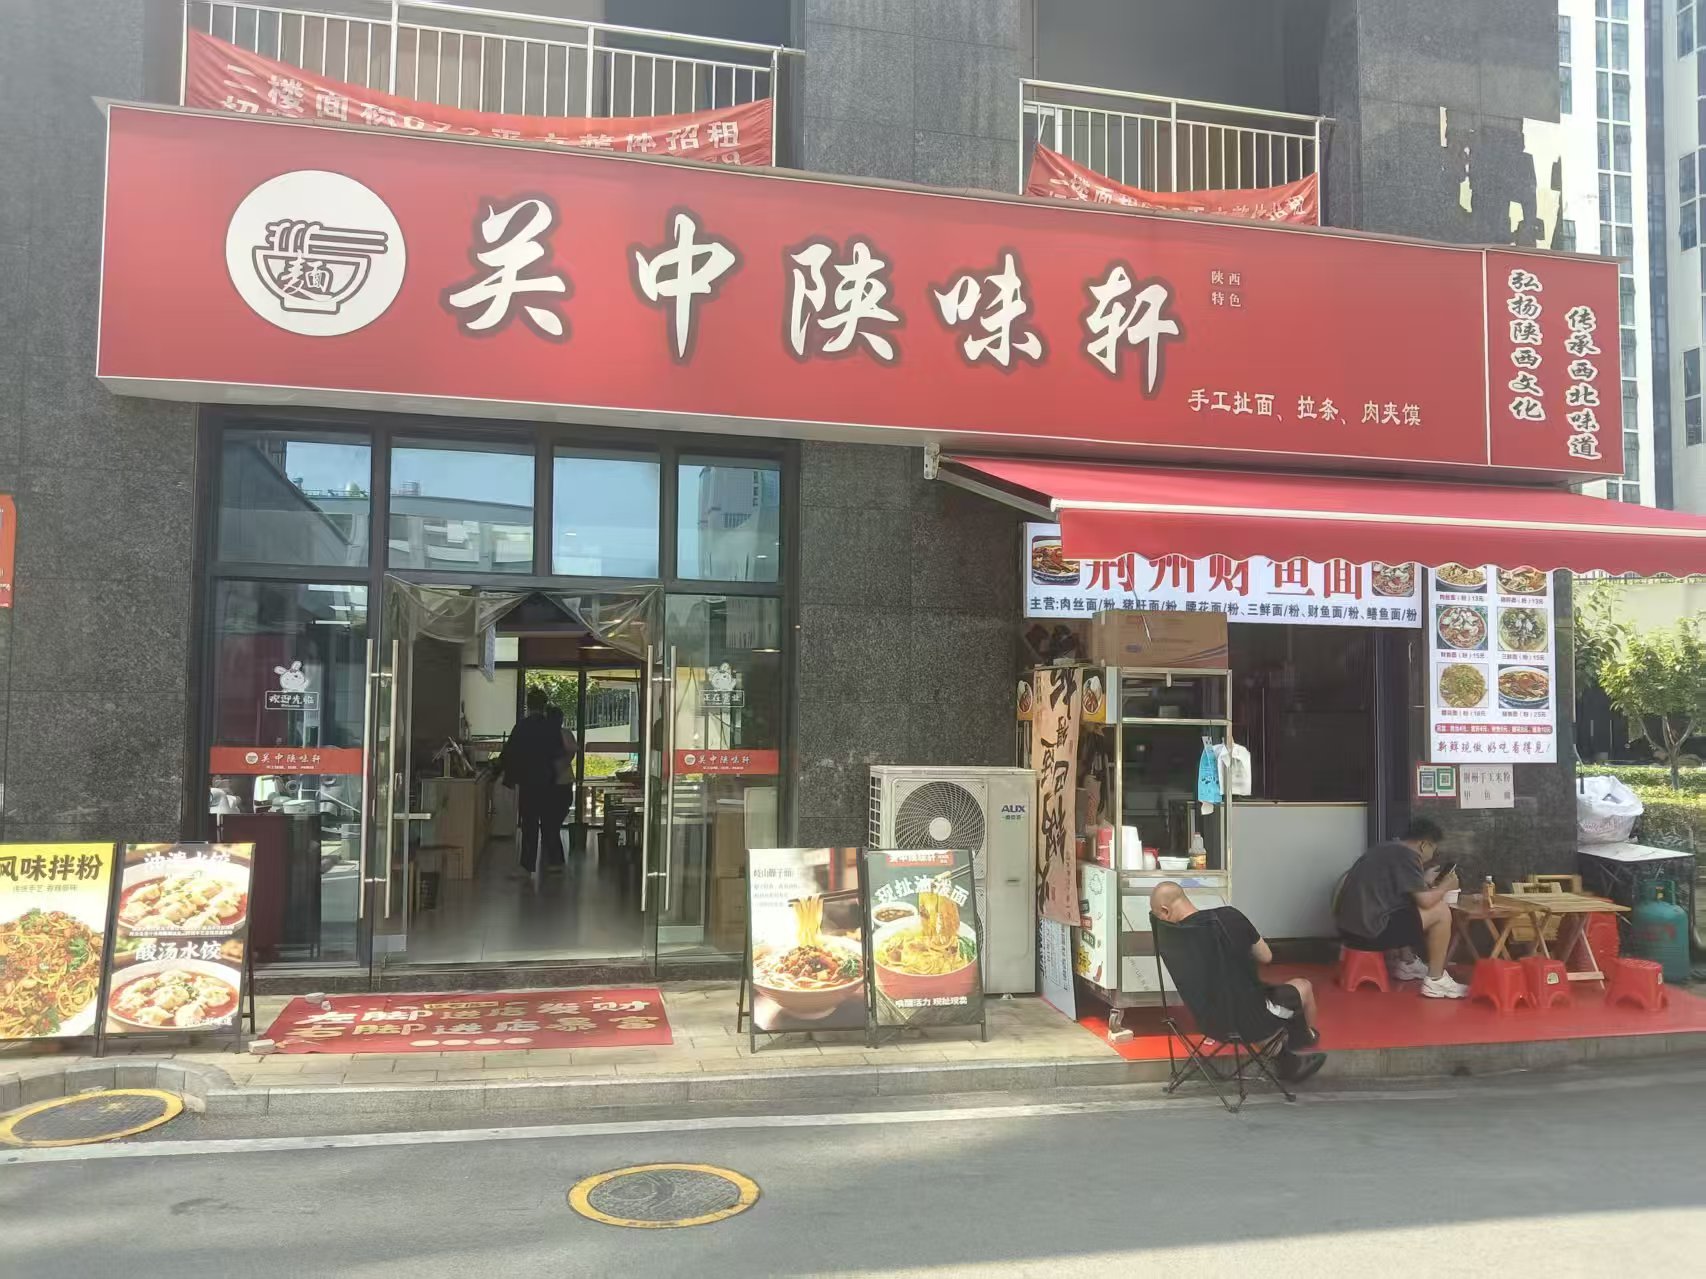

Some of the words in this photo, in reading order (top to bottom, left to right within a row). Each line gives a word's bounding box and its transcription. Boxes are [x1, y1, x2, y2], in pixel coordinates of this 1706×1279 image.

[1211, 271, 1241, 286] 陕西
[449, 199, 1179, 393] 关中陕味轩
[1211, 292, 1242, 308] 特色
[1507, 268, 1546, 421] 弘扬陕西文化
[1564, 305, 1601, 460] 传承西北味道
[1001, 804, 1026, 813] AUX
[0, 854, 104, 881] 风味拌粉
[136, 940, 222, 961] 酸汤水饺
